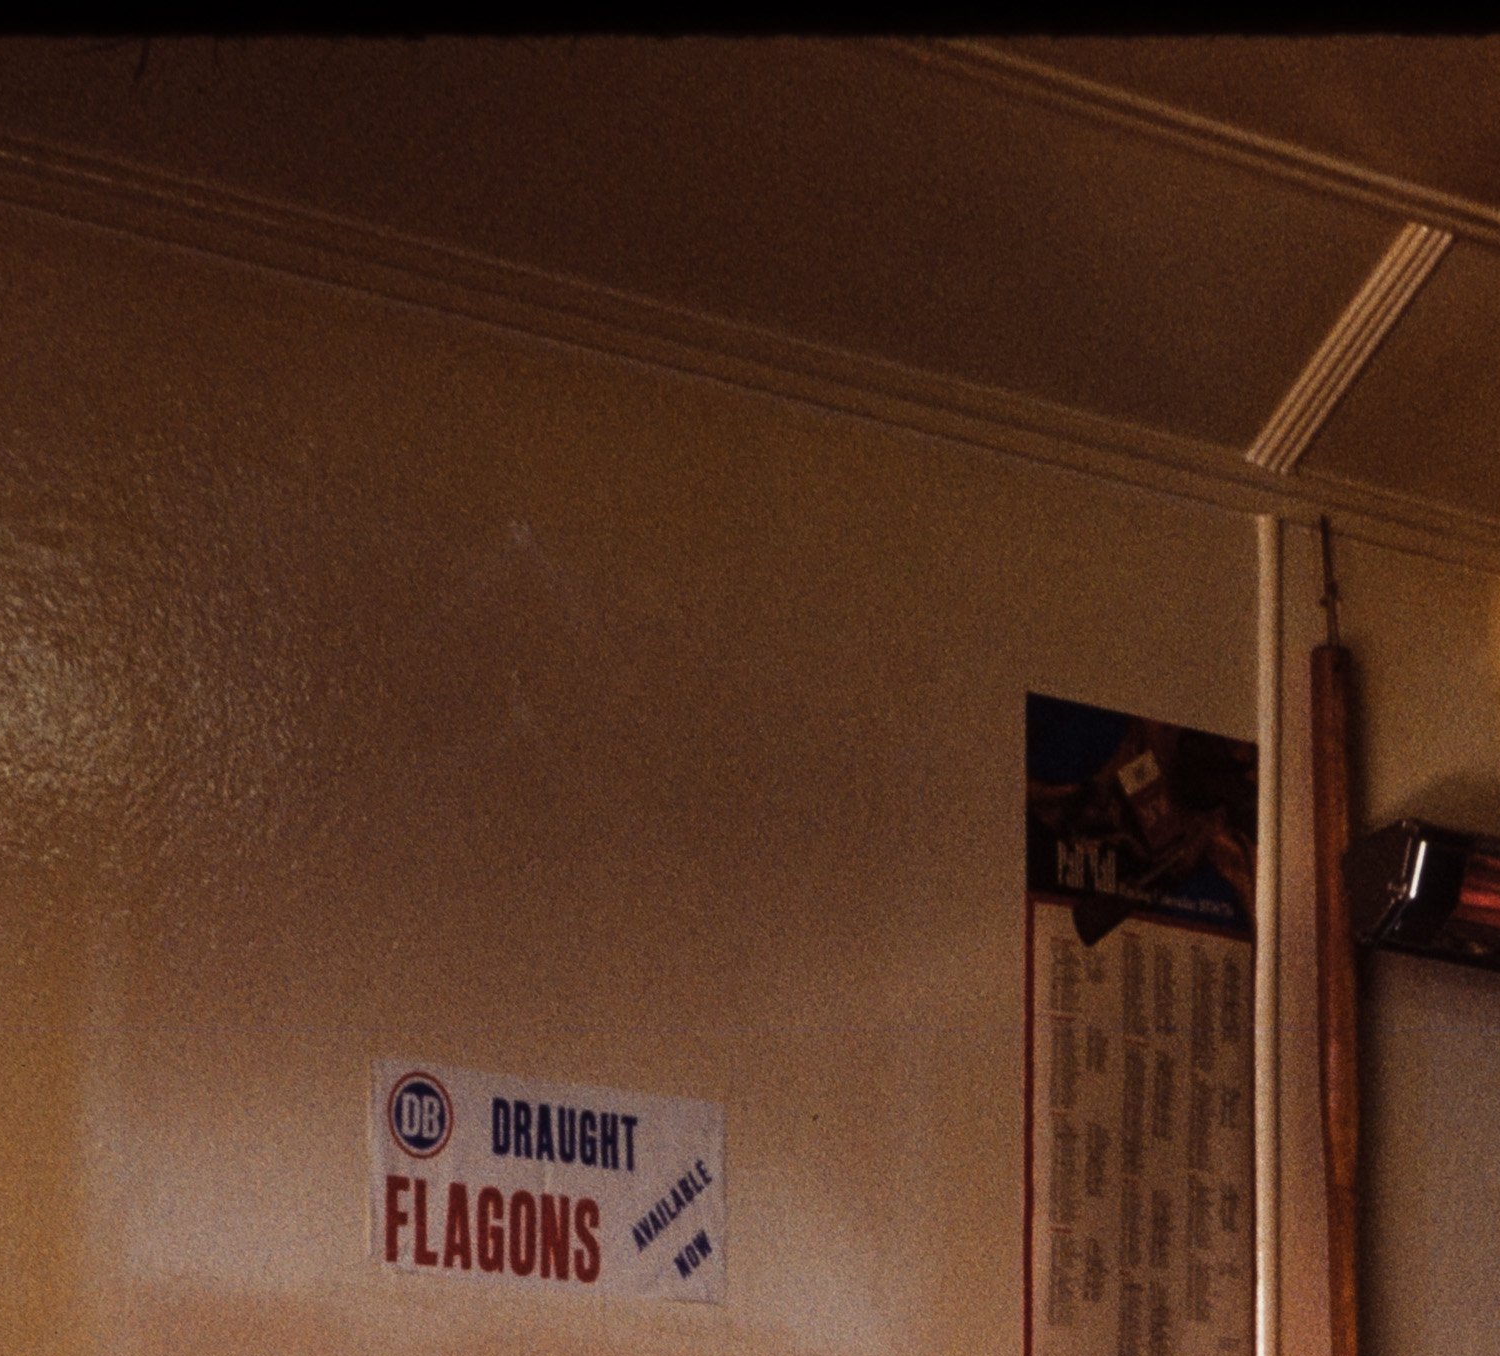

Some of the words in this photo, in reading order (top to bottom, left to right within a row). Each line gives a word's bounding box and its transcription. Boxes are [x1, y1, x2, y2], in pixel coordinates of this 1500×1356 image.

[401, 1092, 441, 1139] DB
[491, 1097, 638, 1171] DRAUGHT
[384, 1174, 602, 1284] FLAGONS
[630, 1159, 713, 1253] AVAILABLE
[673, 1229, 715, 1279] NOW
